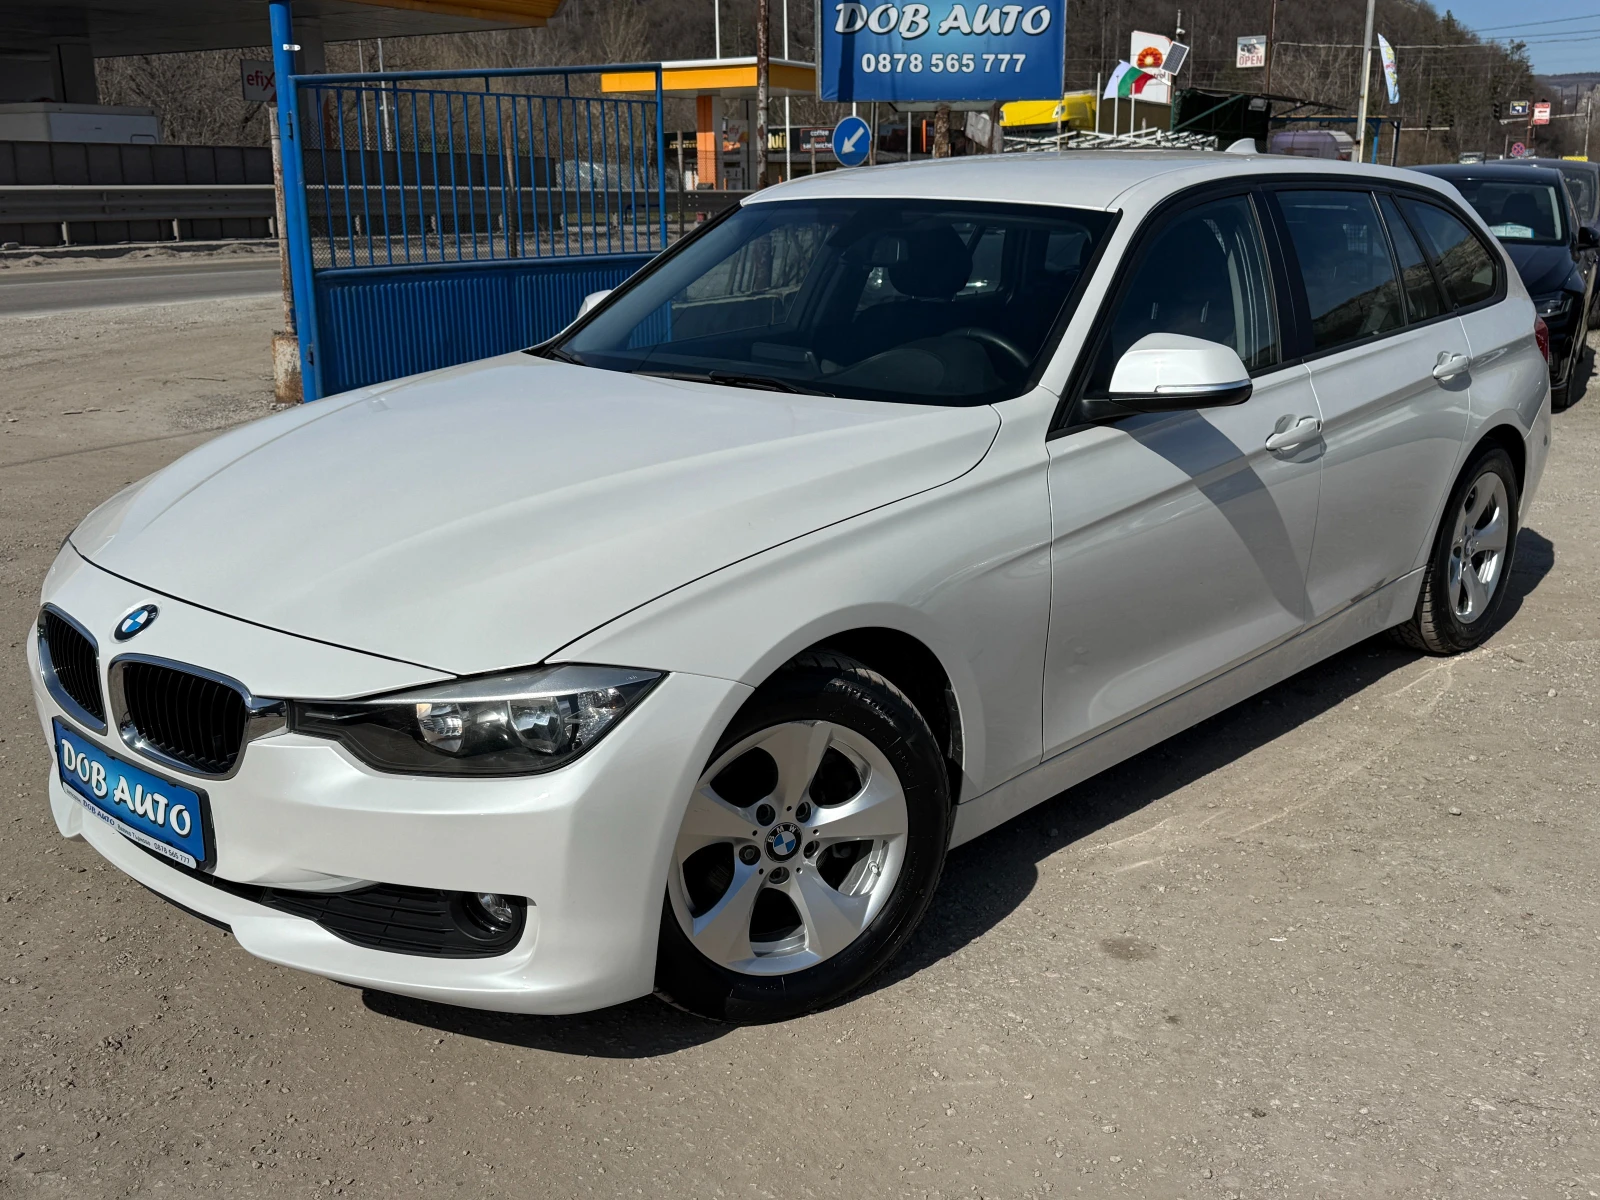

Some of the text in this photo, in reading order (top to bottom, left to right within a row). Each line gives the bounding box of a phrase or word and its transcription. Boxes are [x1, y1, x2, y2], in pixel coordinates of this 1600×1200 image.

[834, 2, 1051, 39] DOB AUTO
[861, 53, 1026, 73] 0878 565 777
[1239, 54, 1263, 66] OPEN
[246, 70, 275, 91] efix
[810, 129, 829, 137] coffee
[61, 738, 192, 838] DOB AUTO
[82, 799, 115, 826] DOB AUTO
